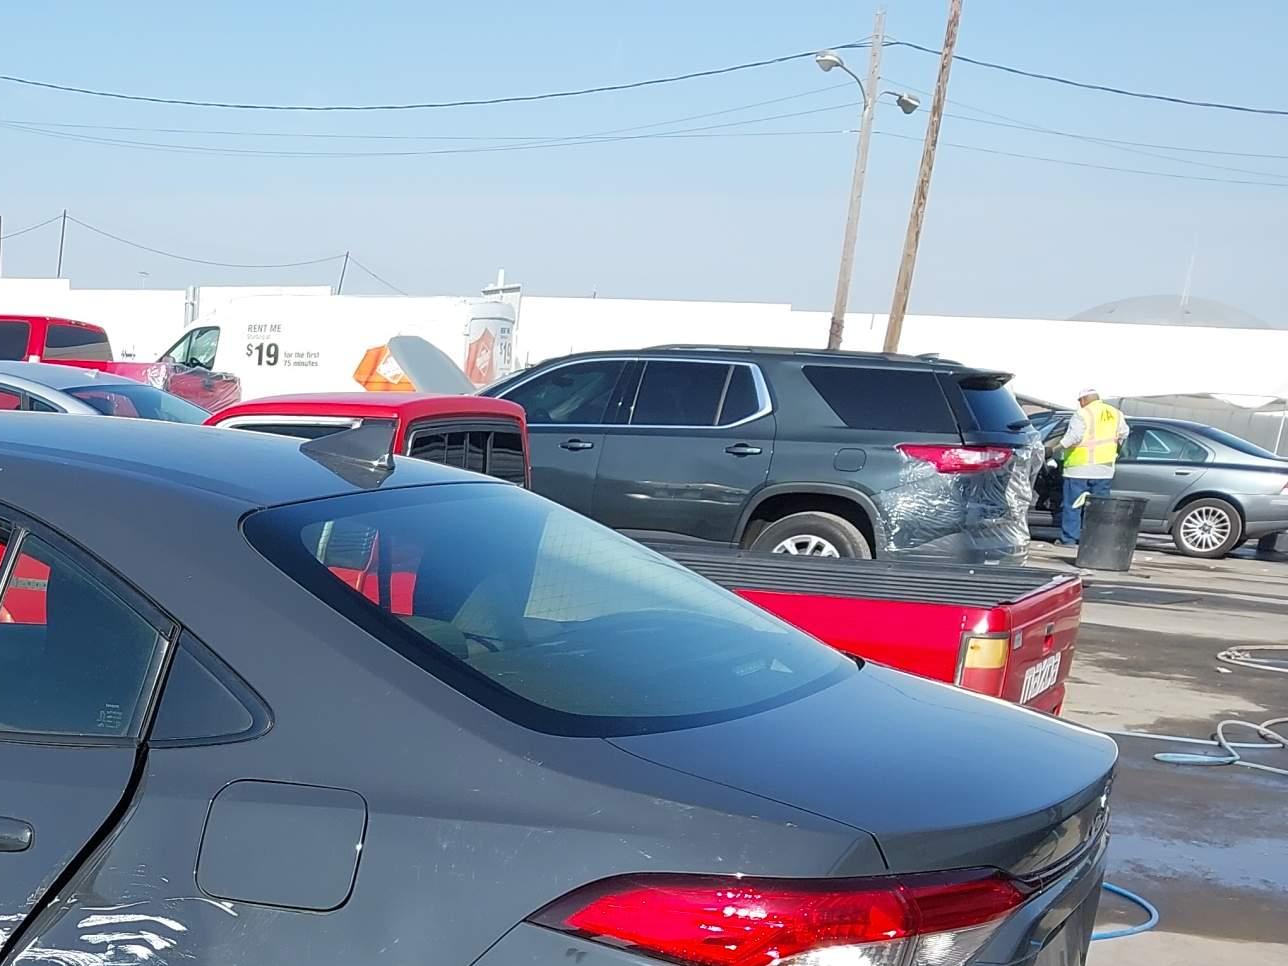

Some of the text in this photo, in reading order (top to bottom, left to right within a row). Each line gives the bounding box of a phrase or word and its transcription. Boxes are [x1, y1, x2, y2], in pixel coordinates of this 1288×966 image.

[248, 324, 282, 333] RENT ME
[246, 342, 279, 366] $19
